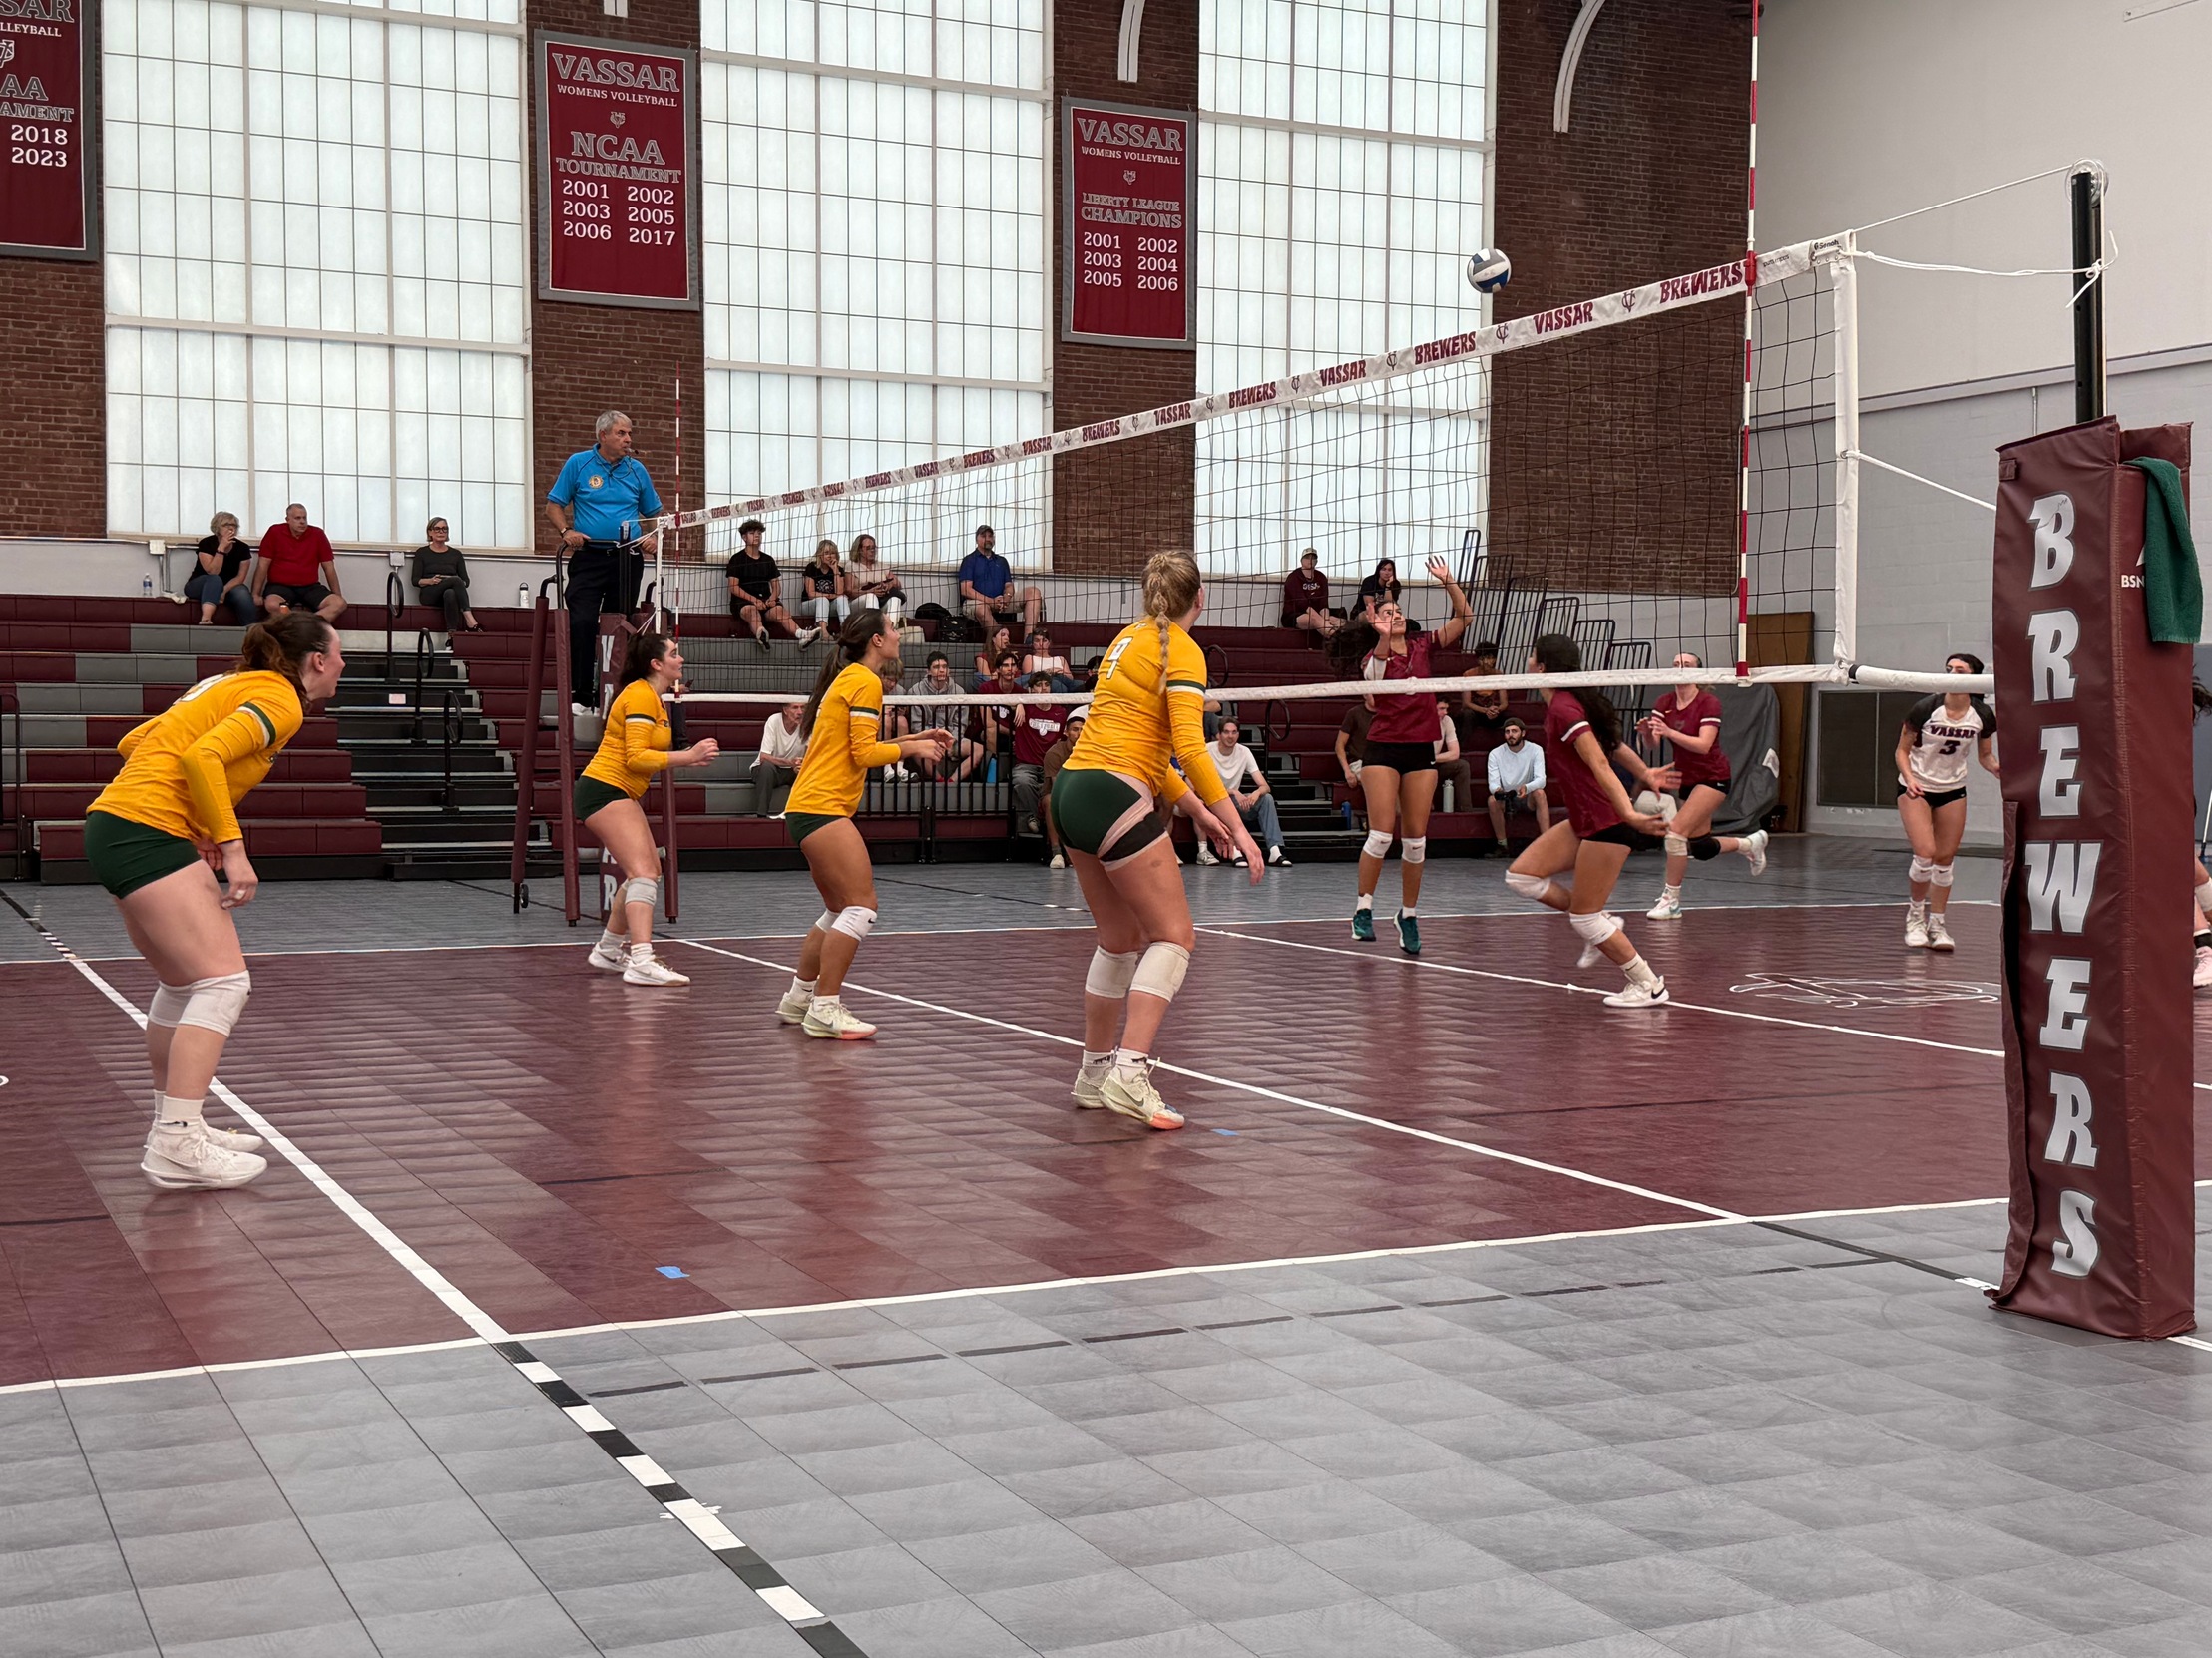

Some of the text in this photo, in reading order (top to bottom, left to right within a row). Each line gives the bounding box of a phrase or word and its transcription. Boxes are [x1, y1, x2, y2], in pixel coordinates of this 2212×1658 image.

[0, 0, 74, 22] SAR
[0, 23, 61, 37] LLEYBALL
[552, 53, 680, 92] VASSAR
[0, 74, 48, 100] AA
[557, 84, 677, 107] WOMENS VOLLEYBALL
[0, 102, 74, 122] AMENT
[11, 125, 67, 145] 2018
[1077, 117, 1182, 151] VASSAR
[11, 148, 67, 167] 2023
[570, 131, 665, 165] NCAA
[1081, 146, 1181, 165] WOMENS VOLLEYBALL
[555, 157, 681, 184] TOURNAMENT
[562, 179, 674, 205] 2001 2002
[1082, 192, 1180, 212] LIBERTY LEAGUE
[563, 201, 675, 225] 2003 2005
[1081, 206, 1182, 229] CHAMPIONS
[563, 220, 676, 246] 2006 2017
[1084, 231, 1178, 254] 2001 2002
[1084, 251, 1178, 273] 2003 2004
[1083, 269, 1178, 291] 2005 2006
[914, 461, 940, 479] VASSAR
[963, 449, 995, 469] BREWERS
[1022, 436, 1052, 456] VASSAR
[1083, 420, 1120, 443] BREWERS
[1154, 403, 1191, 426] VASSAR
[1229, 381, 1277, 409] BREWERS
[1319, 359, 1367, 386] VASSAR
[1414, 331, 1477, 365] BREWERS
[1533, 302, 1594, 334] VASSAR
[1660, 262, 1743, 303] BREWERS
[2121, 575, 2145, 588] BSN
[1931, 725, 1975, 738] VASSAR
[1939, 740, 1961, 755] 3
[2024, 491, 2103, 1280] BREWERS
